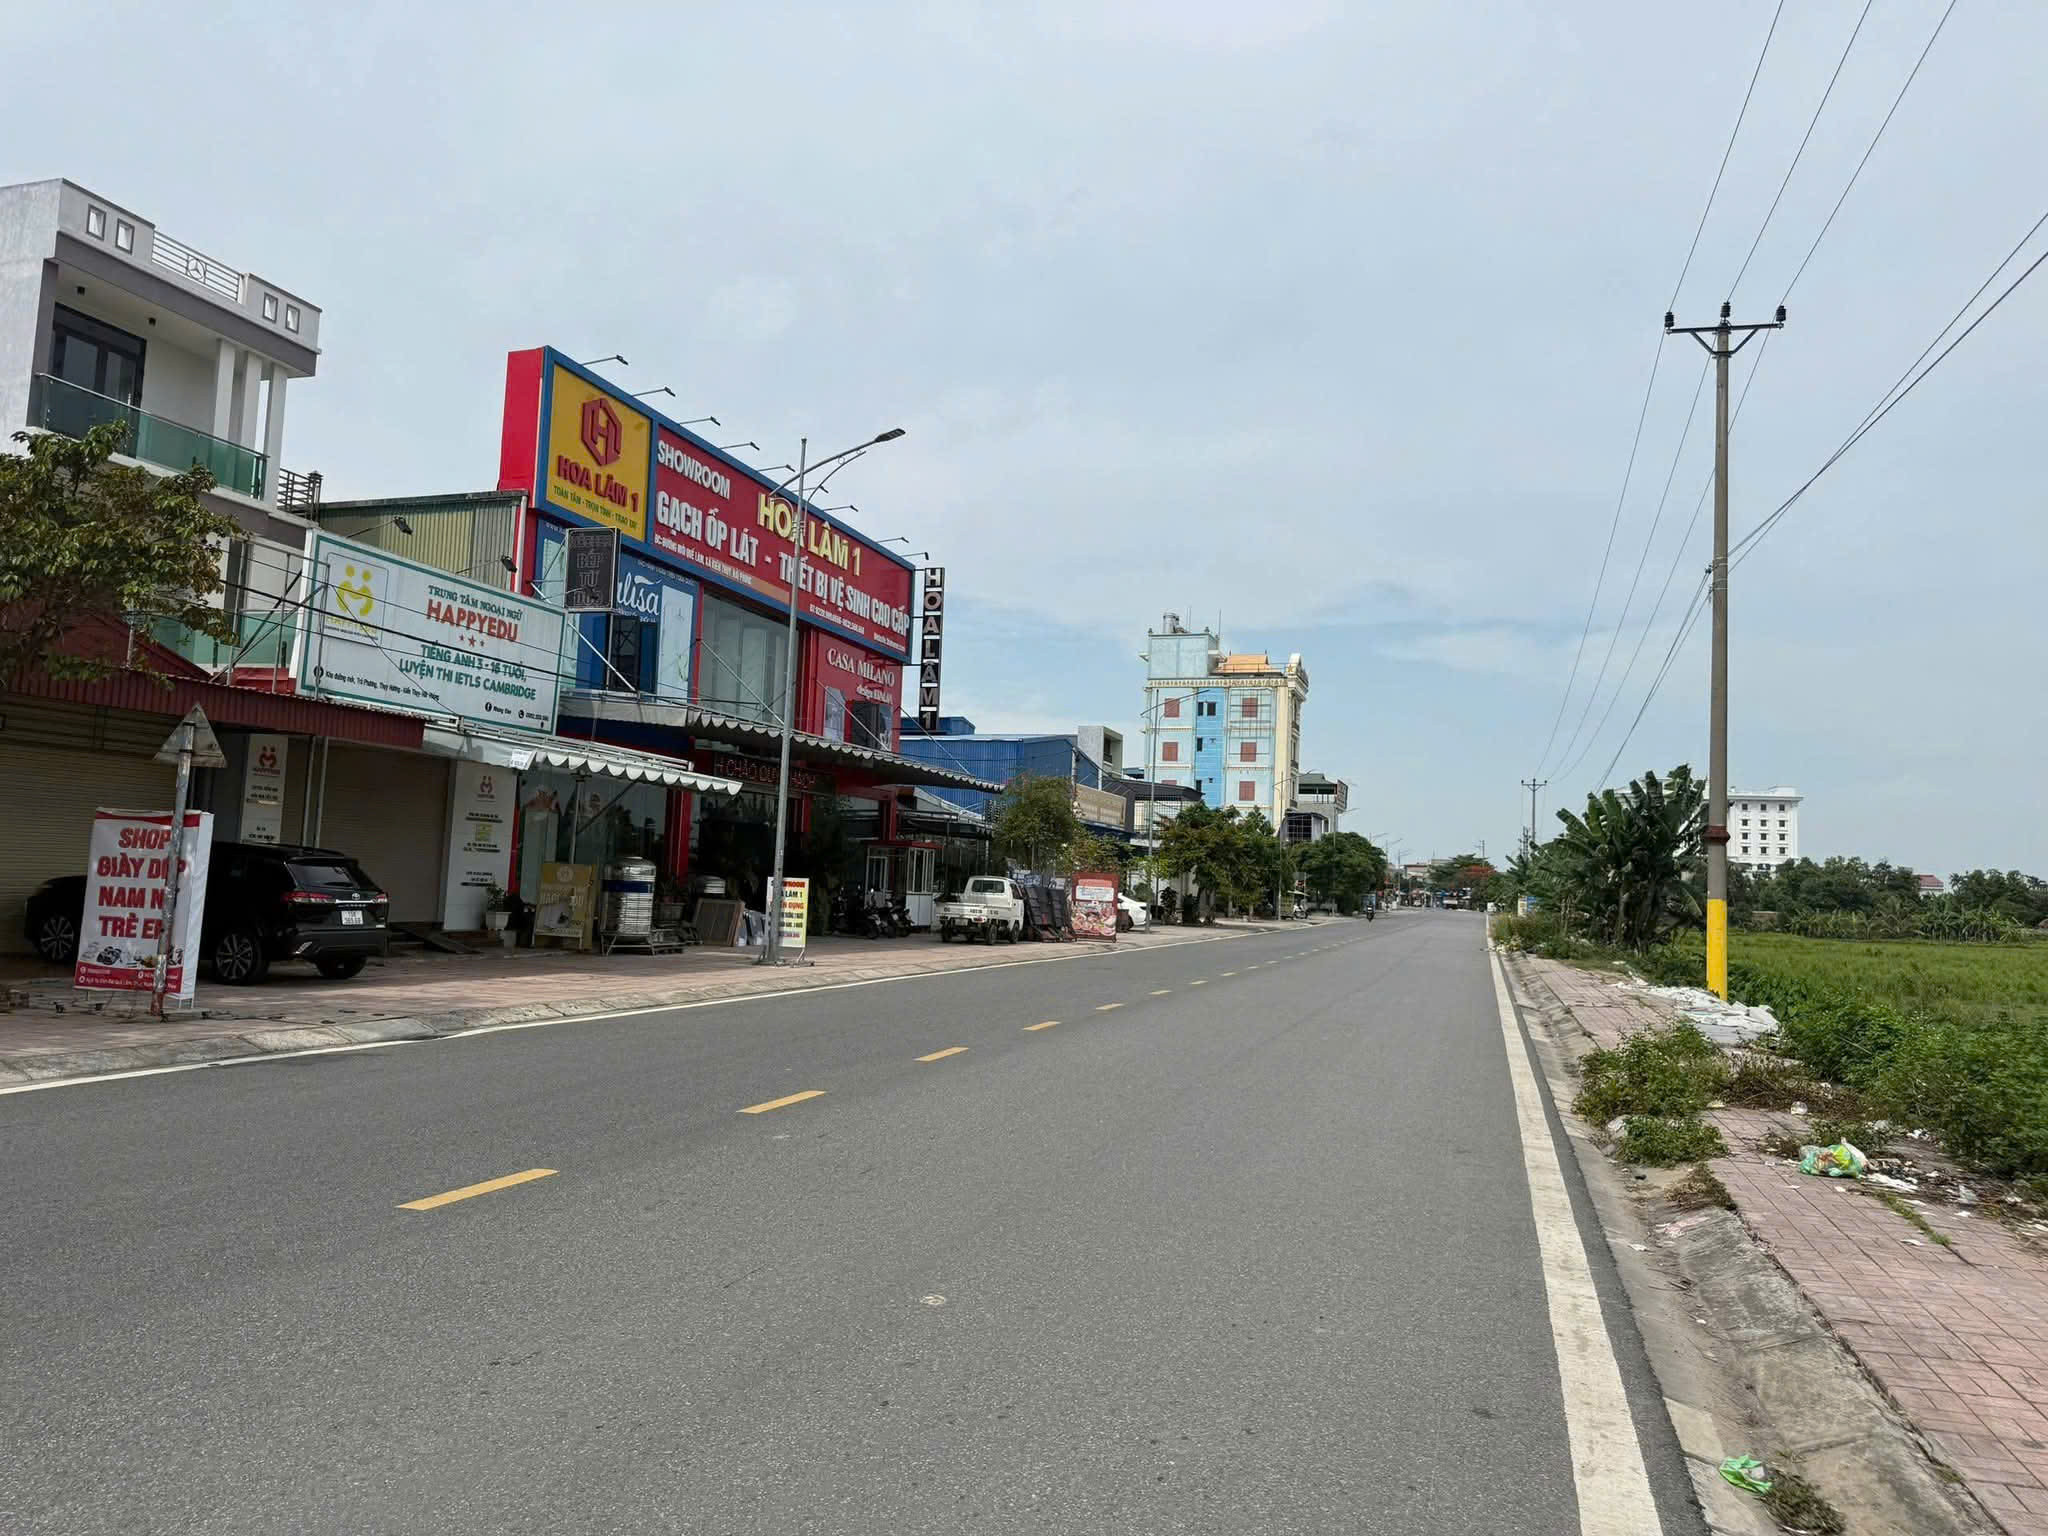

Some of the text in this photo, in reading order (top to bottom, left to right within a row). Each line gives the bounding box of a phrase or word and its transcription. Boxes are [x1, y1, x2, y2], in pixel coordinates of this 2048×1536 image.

[557, 455, 640, 513] HOA LÂM 1
[657, 440, 731, 500] SHOWROOM
[757, 493, 861, 577] HOA LÂM 1
[656, 490, 703, 541] GẠCH
[706, 508, 728, 552] ỐP
[729, 527, 759, 568] LÁT
[815, 570, 829, 605] BỊ
[829, 577, 845, 612] VỆ
[844, 585, 871, 620] SINH
[871, 598, 891, 629] CAO
[890, 605, 911, 637] CẤP
[428, 585, 459, 603] TRUNG
[459, 594, 479, 607] TÂM
[426, 598, 520, 642] HAPPYEDU
[399, 658, 538, 701] LUYỆN THI IETLS CAMBRIDGE
[453, 652, 476, 669] ANH
[476, 658, 484, 671] 3
[826, 647, 896, 688] CASA MILANO
[118, 827, 172, 850] SHOP
[96, 852, 145, 878] GIÀY
[98, 885, 146, 909] NAM
[98, 912, 139, 938] TRẺ
